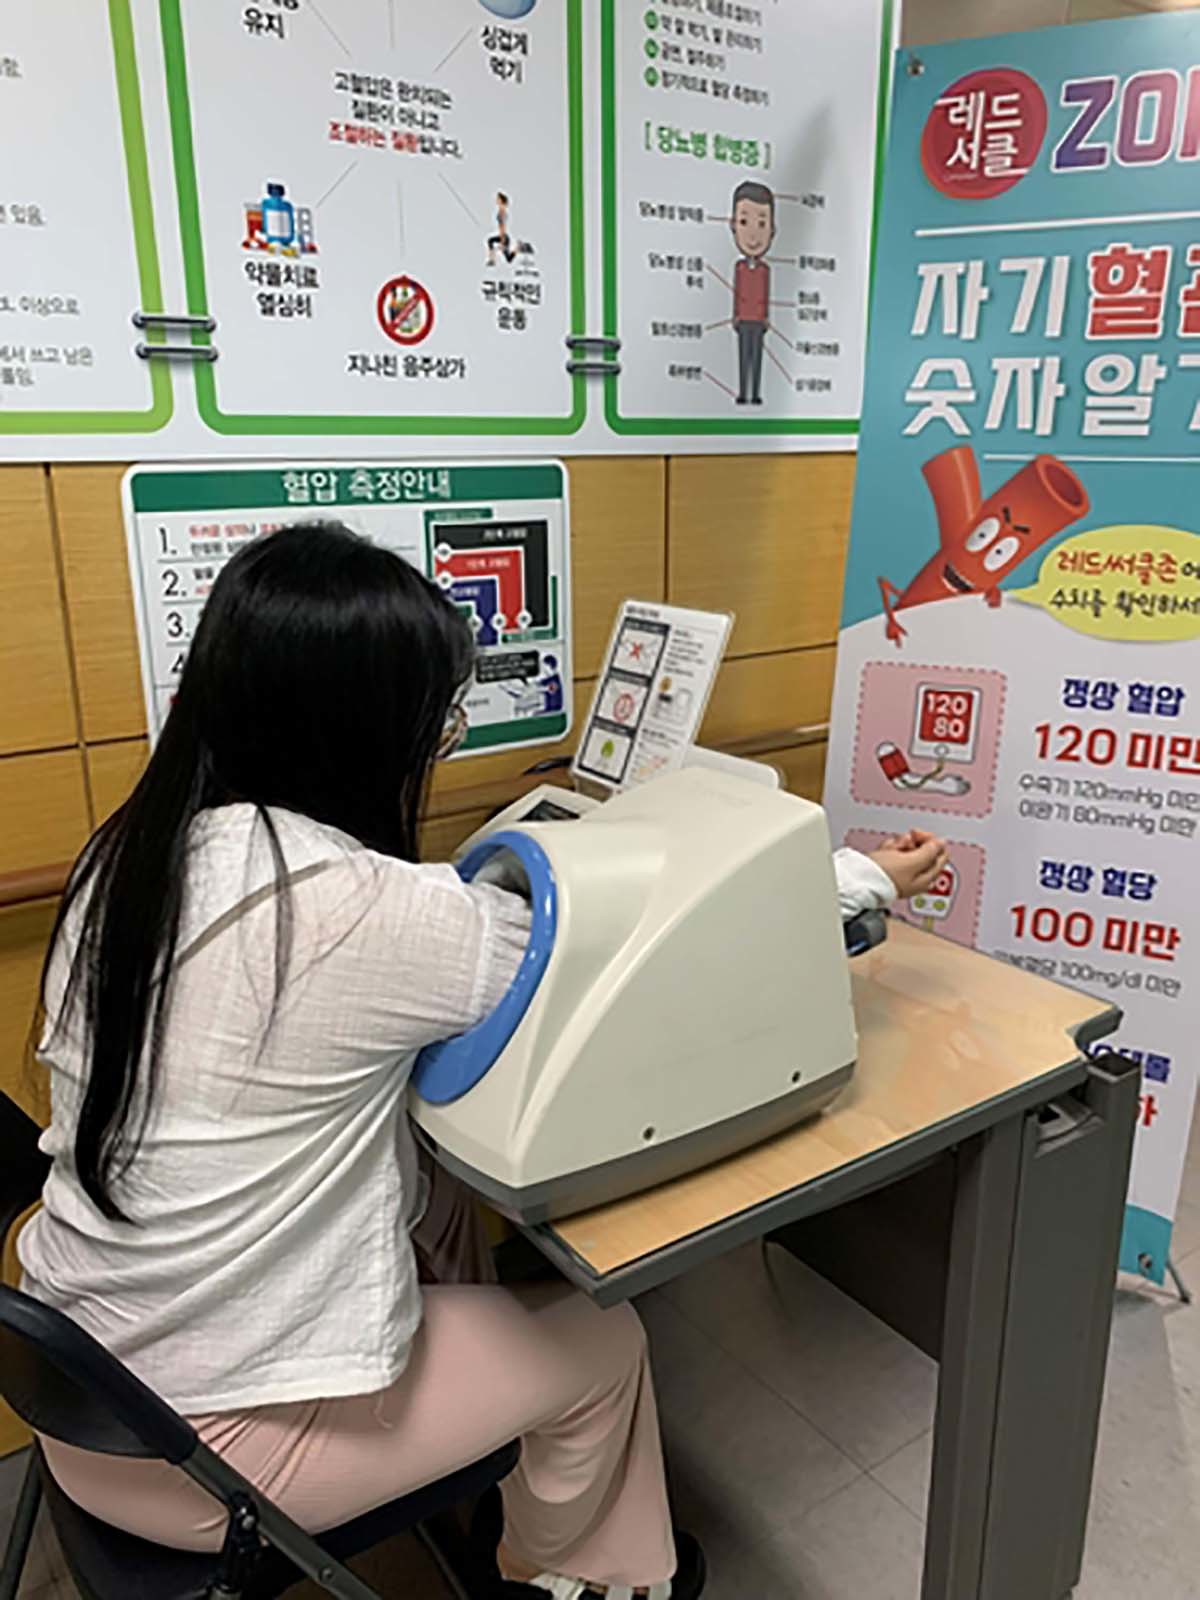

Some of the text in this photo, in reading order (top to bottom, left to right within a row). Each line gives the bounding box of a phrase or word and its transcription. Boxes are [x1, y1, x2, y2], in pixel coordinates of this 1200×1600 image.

[243, 7, 284, 39] 유지
[480, 24, 528, 56] 싱겁게
[490, 56, 522, 84] 먹기
[334, 72, 452, 110] 고혈압은 완치되는
[351, 100, 440, 131] 질환이 아니고
[934, 89, 1023, 130] 레드
[329, 121, 463, 159] 조절하는 질환입니다.
[658, 126, 707, 159] 당뇨병
[713, 133, 760, 167] 합병증
[946, 130, 1030, 177] 서클
[244, 261, 319, 288] 약물치료
[257, 293, 312, 319] 열심히
[482, 281, 541, 305] 규칙적인
[498, 307, 526, 331] 운동
[347, 354, 397, 377] 지나친
[283, 466, 451, 503] 혈압 측정안내
[161, 569, 188, 597] 2.
[1049, 588, 1107, 619] 수치를
[166, 611, 191, 638] 3.
[927, 693, 968, 718] 120
[1063, 678, 1187, 717] 정상 혈압
[1034, 722, 1200, 776] 120 미만
[1040, 860, 1158, 901] 정상 혈당
[1010, 904, 1182, 962] 100 미만
